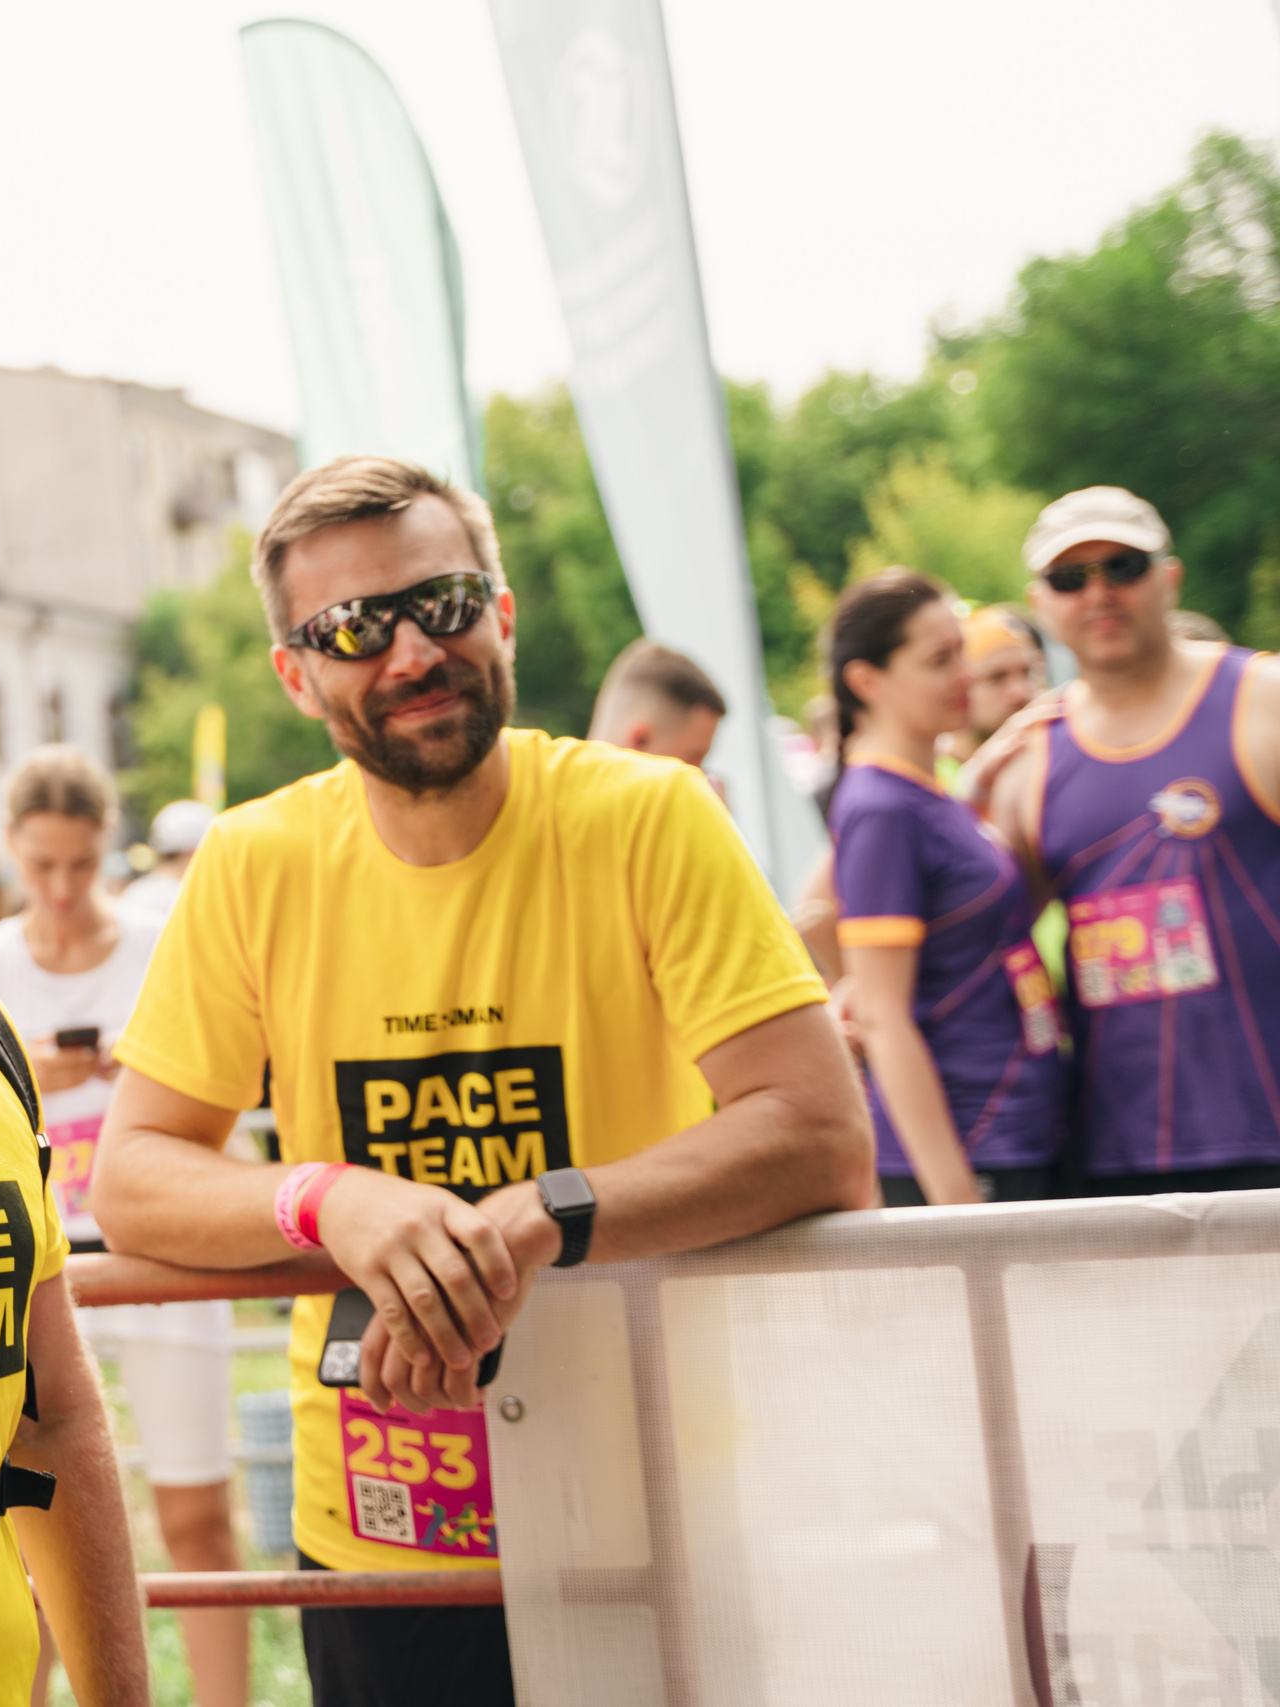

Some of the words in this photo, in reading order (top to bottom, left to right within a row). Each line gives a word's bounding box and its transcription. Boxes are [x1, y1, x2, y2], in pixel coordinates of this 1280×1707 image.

[364, 1067, 541, 1134] PACE
[367, 1131, 547, 1187] TEAM
[345, 1417, 478, 1490] 253
